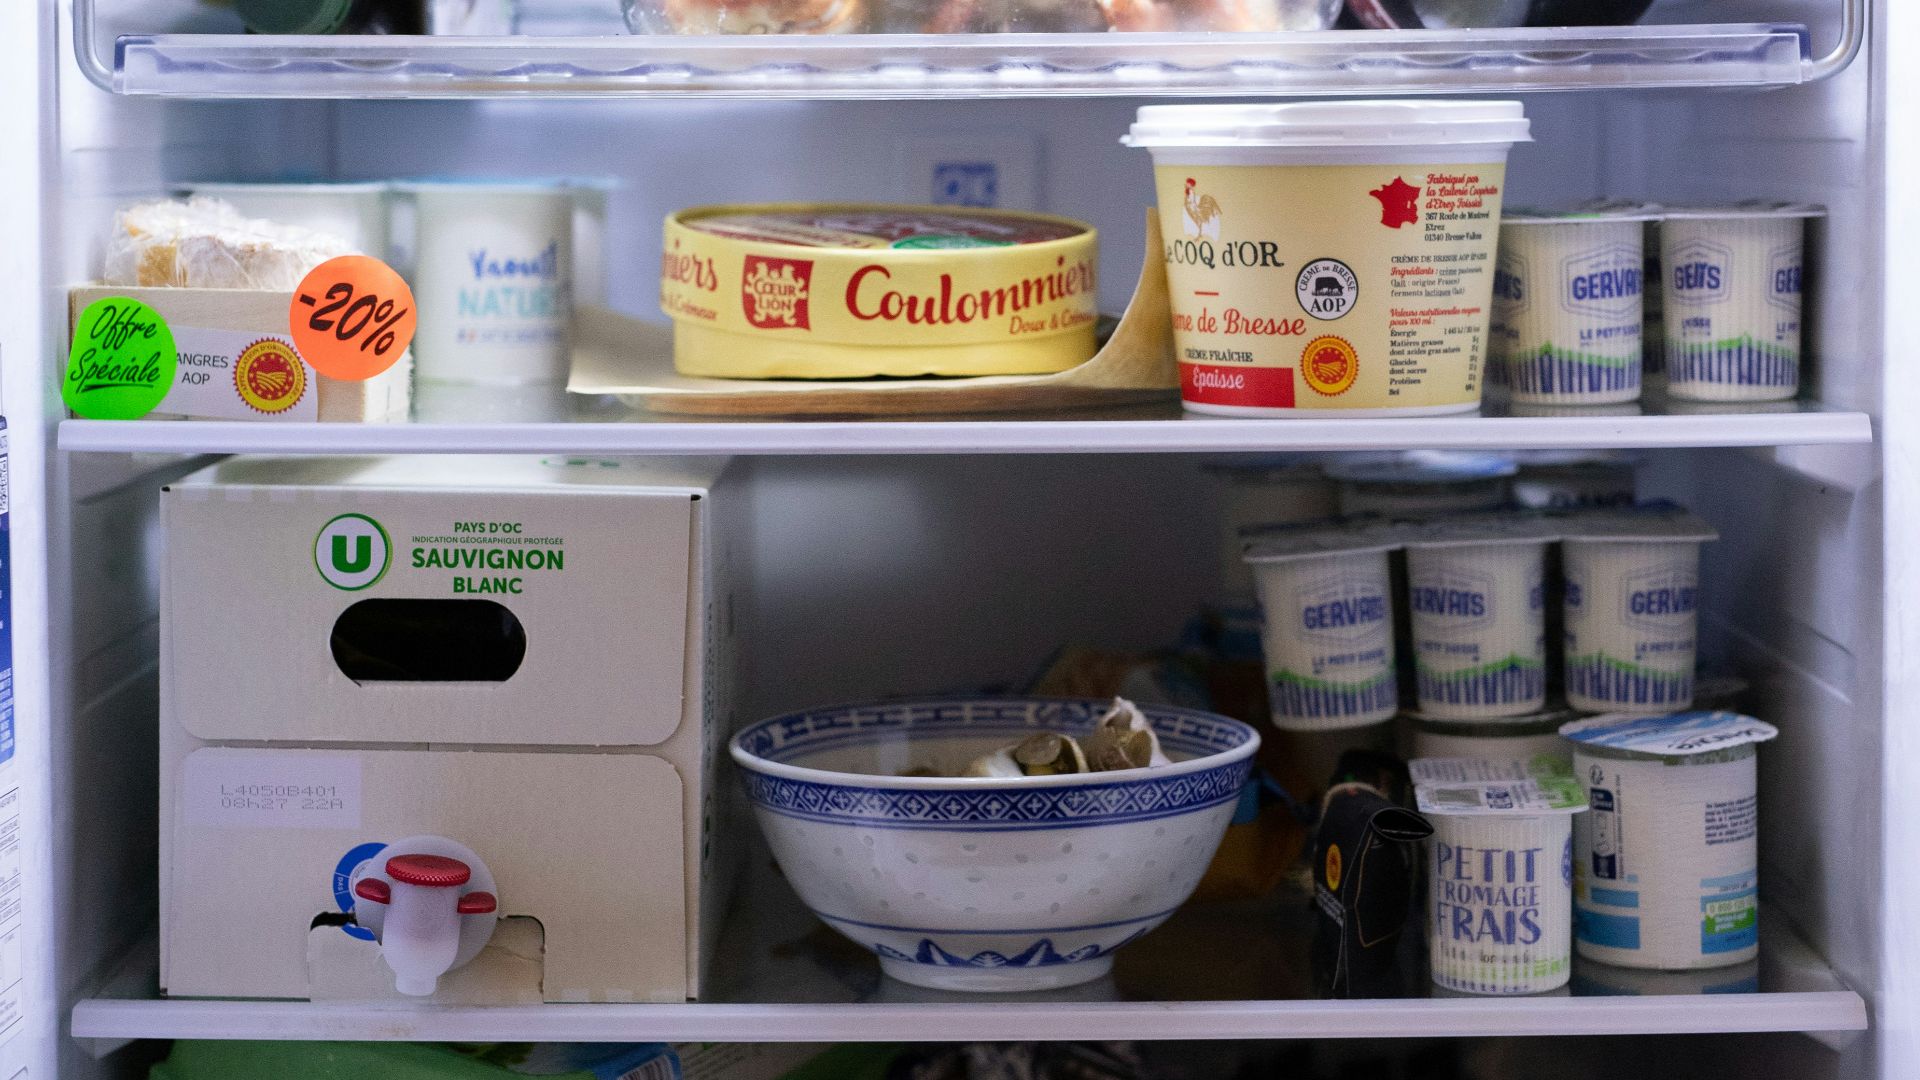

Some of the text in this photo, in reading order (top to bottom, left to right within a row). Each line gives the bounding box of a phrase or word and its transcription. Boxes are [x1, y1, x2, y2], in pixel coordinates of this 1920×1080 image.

[1440, 212, 1458, 220] Route
[1174, 239, 1216, 269] COQ
[1222, 241, 1285, 268] d'OR
[1391, 254, 1419, 263] CRÈME
[1421, 255, 1432, 263] DE
[1299, 264, 1321, 292] CREME
[1333, 264, 1356, 292] BRESSE
[1390, 289, 1423, 297] ferments
[757, 298, 792, 312] LION
[1310, 297, 1346, 313] AOP
[90, 304, 158, 350] Offre
[299, 282, 409, 357] -20%
[1197, 307, 1218, 334] de
[1223, 308, 1308, 336] Bresse
[176, 352, 229, 369] ANGRES
[1209, 348, 1254, 362] FRAÎCHE
[1389, 358, 1417, 366] Glucides
[69, 347, 161, 394] Spéciale
[181, 371, 211, 385] AOP
[1192, 364, 1246, 392] Épaisse
[453, 521, 523, 534] PAYS D'OC
[412, 535, 564, 546] INDICATION GÉOGRAPHIQUE PROTÉGÉE
[331, 534, 372, 573] U
[411, 547, 564, 571] SAUVIGNON
[452, 576, 523, 595] BLANC
[1436, 841, 1543, 883] PETIT
[1437, 878, 1541, 908] FROMAGE
[1436, 902, 1542, 946] FRAIS
